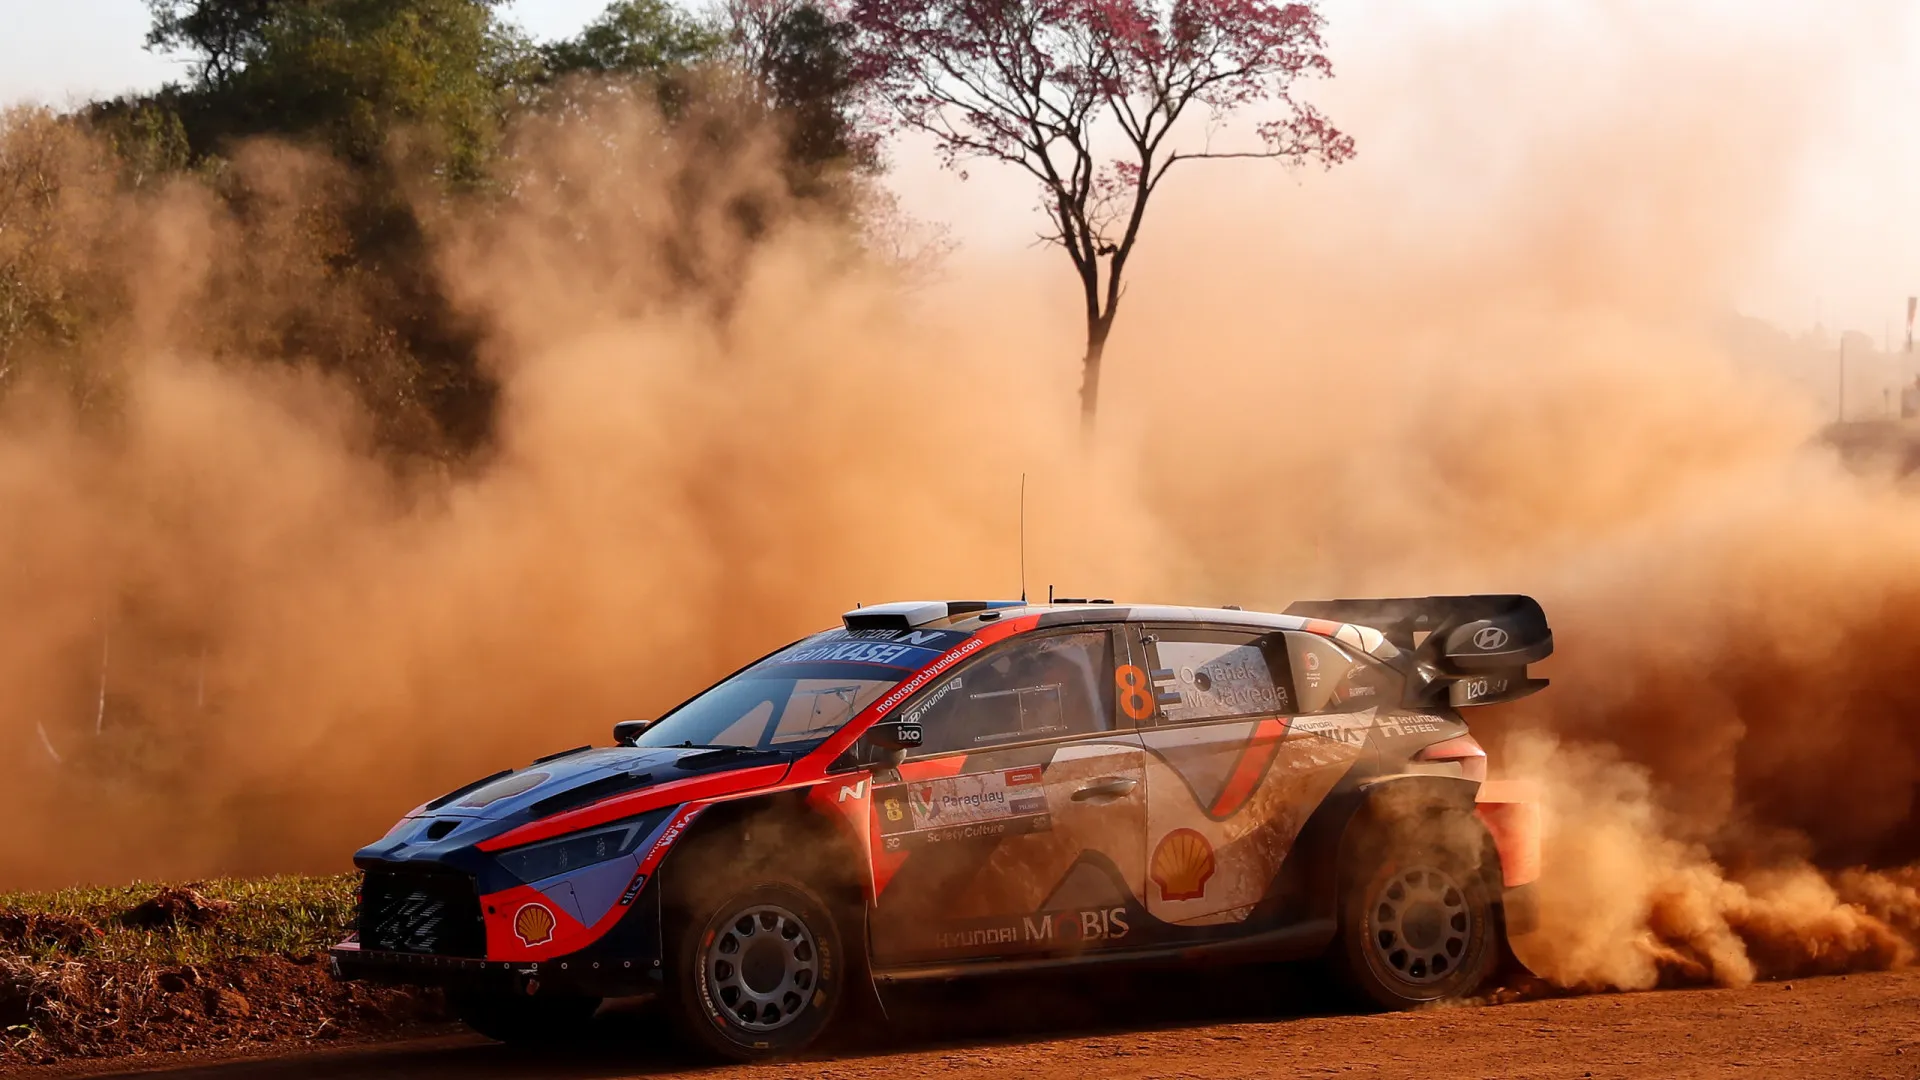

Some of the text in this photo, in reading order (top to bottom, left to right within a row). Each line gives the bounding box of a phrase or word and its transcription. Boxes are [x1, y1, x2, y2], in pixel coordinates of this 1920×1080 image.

[876, 638, 984, 713] motorsport.hyundai.com
[1204, 661, 1257, 682] Tänak
[920, 684, 951, 714] HYUNDAI
[1115, 664, 1154, 720] 8
[1467, 681, 1488, 700] i20
[1295, 721, 1334, 731] HYUNDAI
[1399, 715, 1444, 725] HYUNDAI
[1404, 725, 1441, 734] STEEL
[838, 780, 865, 803] N
[942, 791, 1005, 808] Paraguay
[884, 798, 903, 821] 8
[646, 825, 675, 861] HYUNDAI
[886, 837, 901, 849] SC
[927, 824, 1006, 843] SafetyCulture
[936, 907, 1130, 948] HYUNDAI MOBIS
